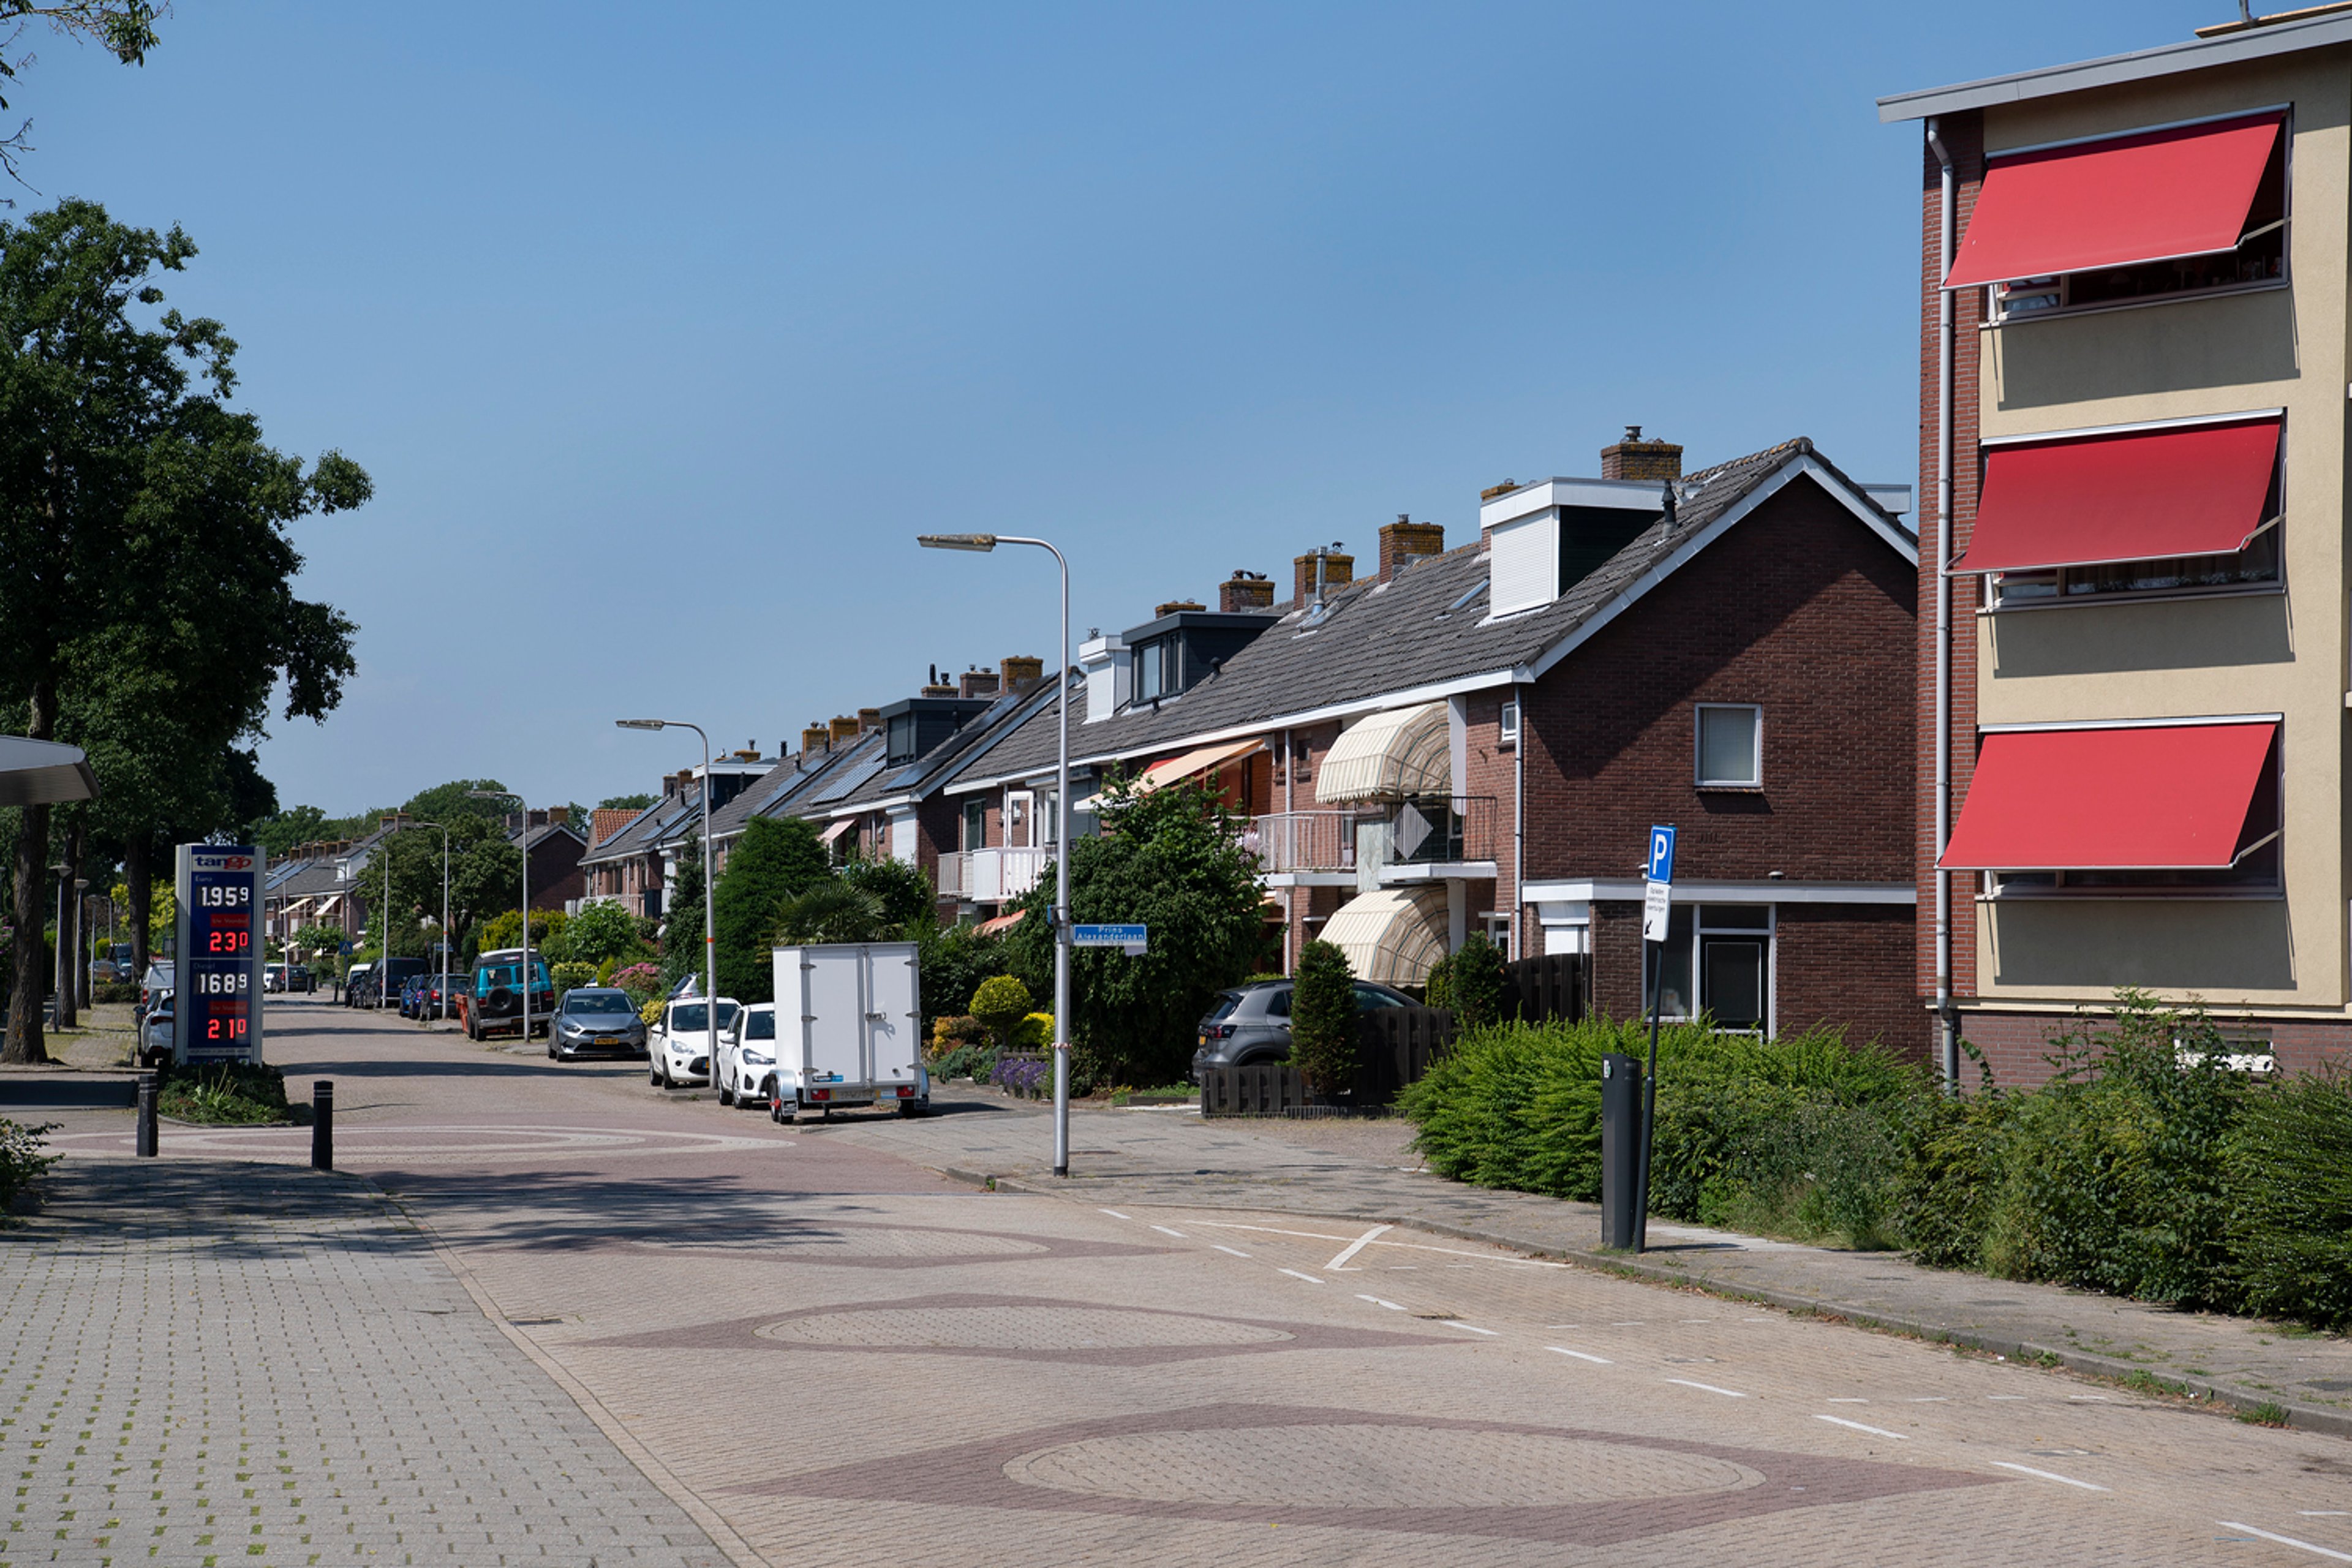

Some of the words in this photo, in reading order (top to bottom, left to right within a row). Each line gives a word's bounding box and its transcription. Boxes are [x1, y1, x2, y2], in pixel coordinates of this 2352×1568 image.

[195, 856, 252, 870] tango
[1653, 834, 1667, 875] P
[209, 931, 249, 952] 230
[208, 1019, 247, 1039] 210
